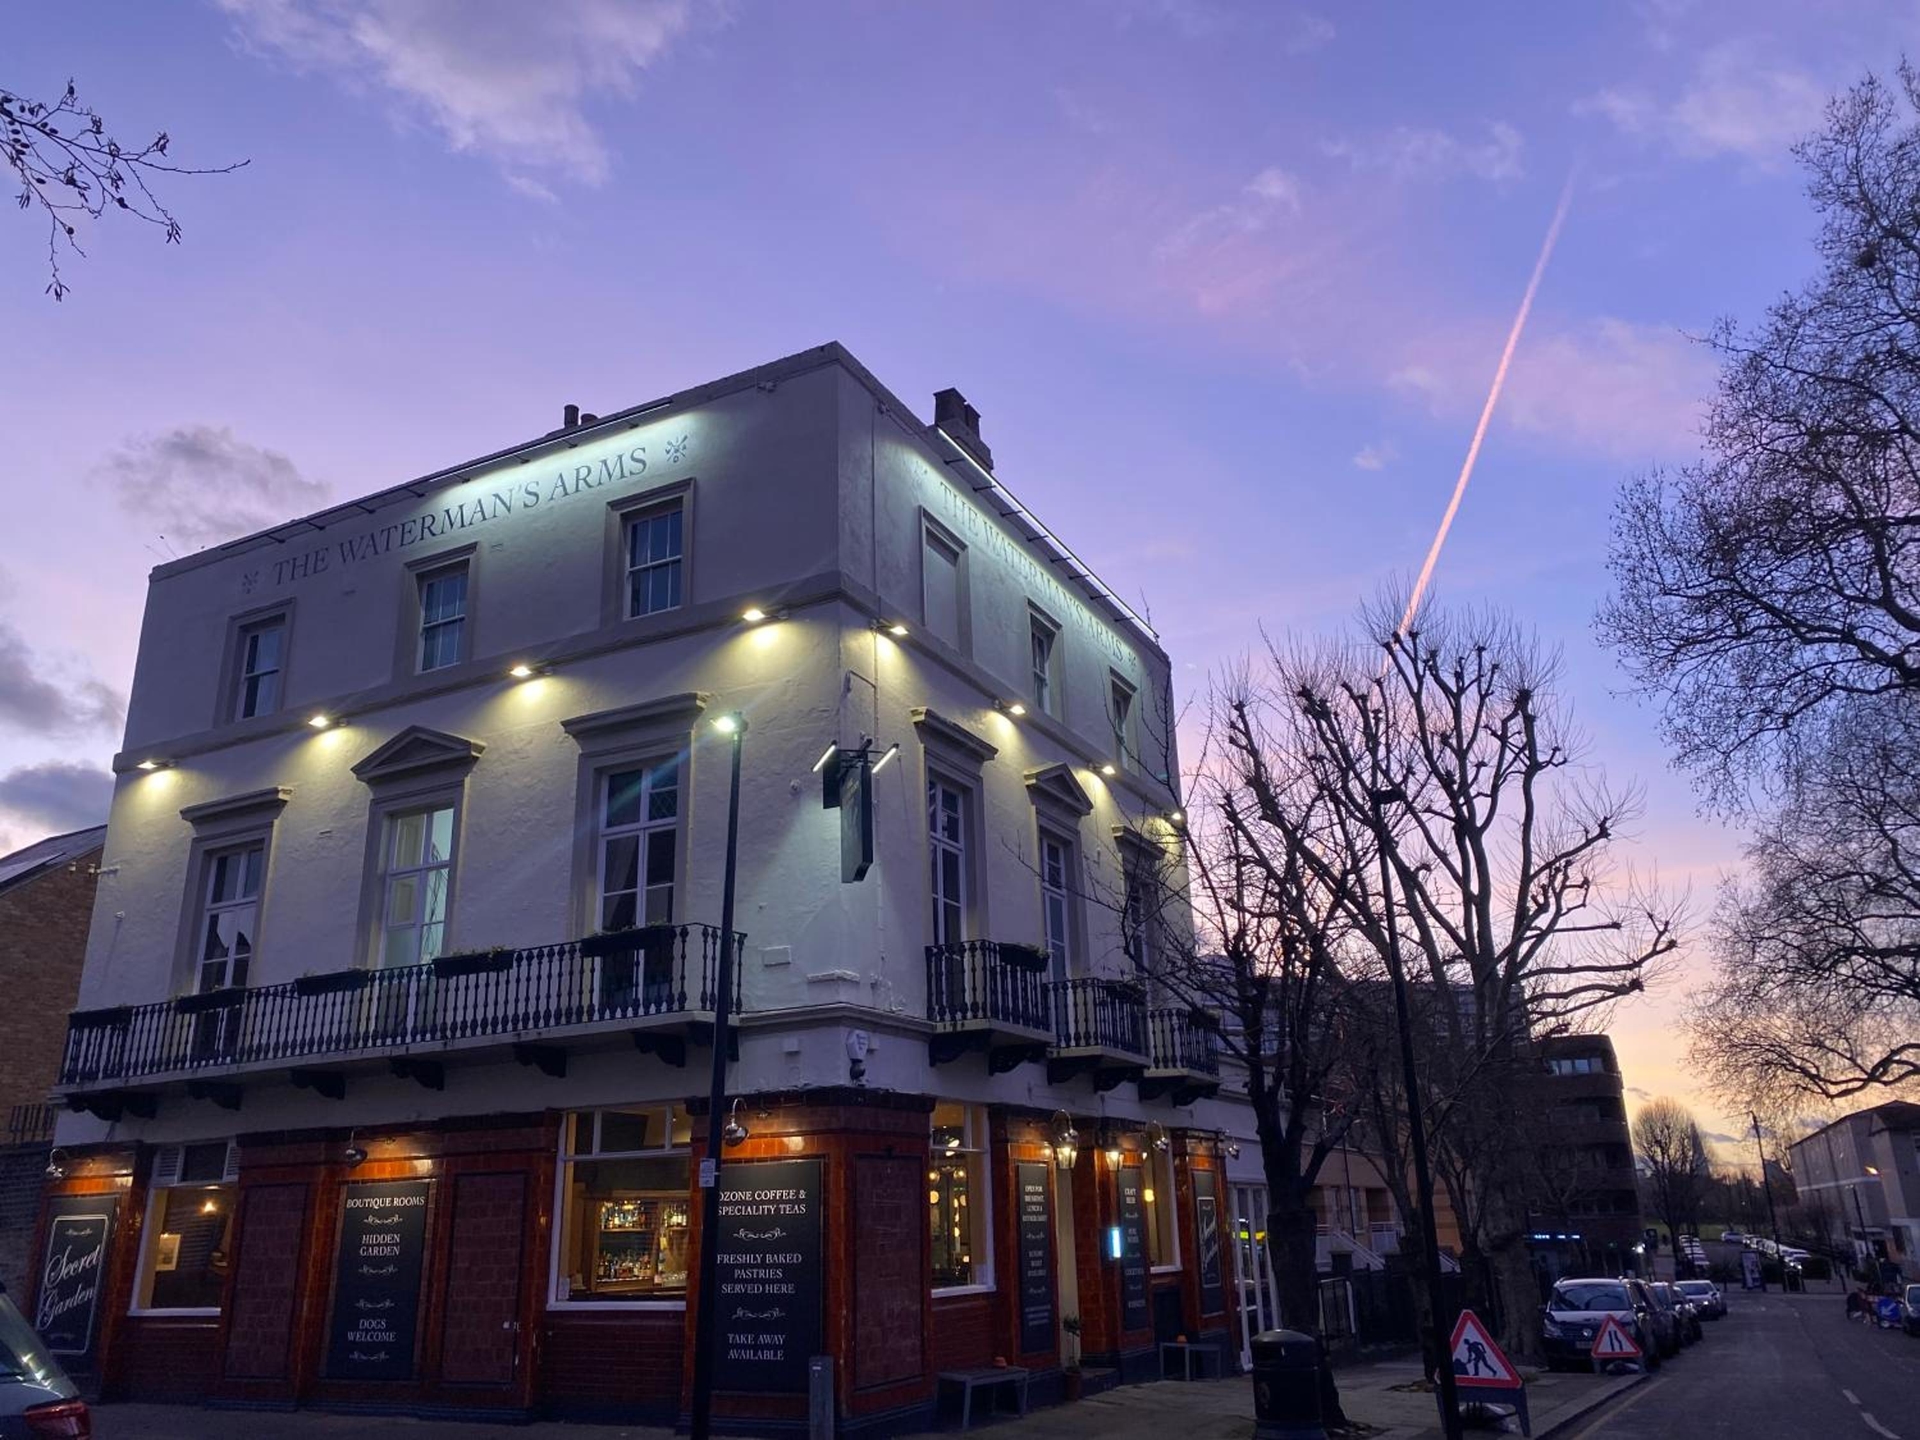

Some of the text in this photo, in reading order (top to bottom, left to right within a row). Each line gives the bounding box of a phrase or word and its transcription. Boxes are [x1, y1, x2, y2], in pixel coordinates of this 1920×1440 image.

[274, 446, 648, 586] THE WATERMAN'S ARMS
[940, 481, 1125, 663] THE WATERMAN'S ARMS
[754, 1190, 796, 1200] COFFEE
[798, 1189, 807, 1200] &
[346, 1196, 425, 1209] BOUTIQUE ROOMS
[778, 1204, 806, 1214] TEAS
[362, 1234, 400, 1244] HIDDEN
[360, 1246, 400, 1256] GARDEN
[717, 1253, 802, 1264] FRESHLY BAKED
[45, 1244, 101, 1288] Secret
[734, 1268, 783, 1279] PASTRIES
[721, 1284, 796, 1294] SERVED HERE
[37, 1283, 94, 1330] Garden
[358, 1318, 386, 1330] DOGS
[347, 1331, 396, 1342] WELCOME
[727, 1334, 786, 1345] TAKE AWAY
[727, 1349, 784, 1360] AVAILABLE
